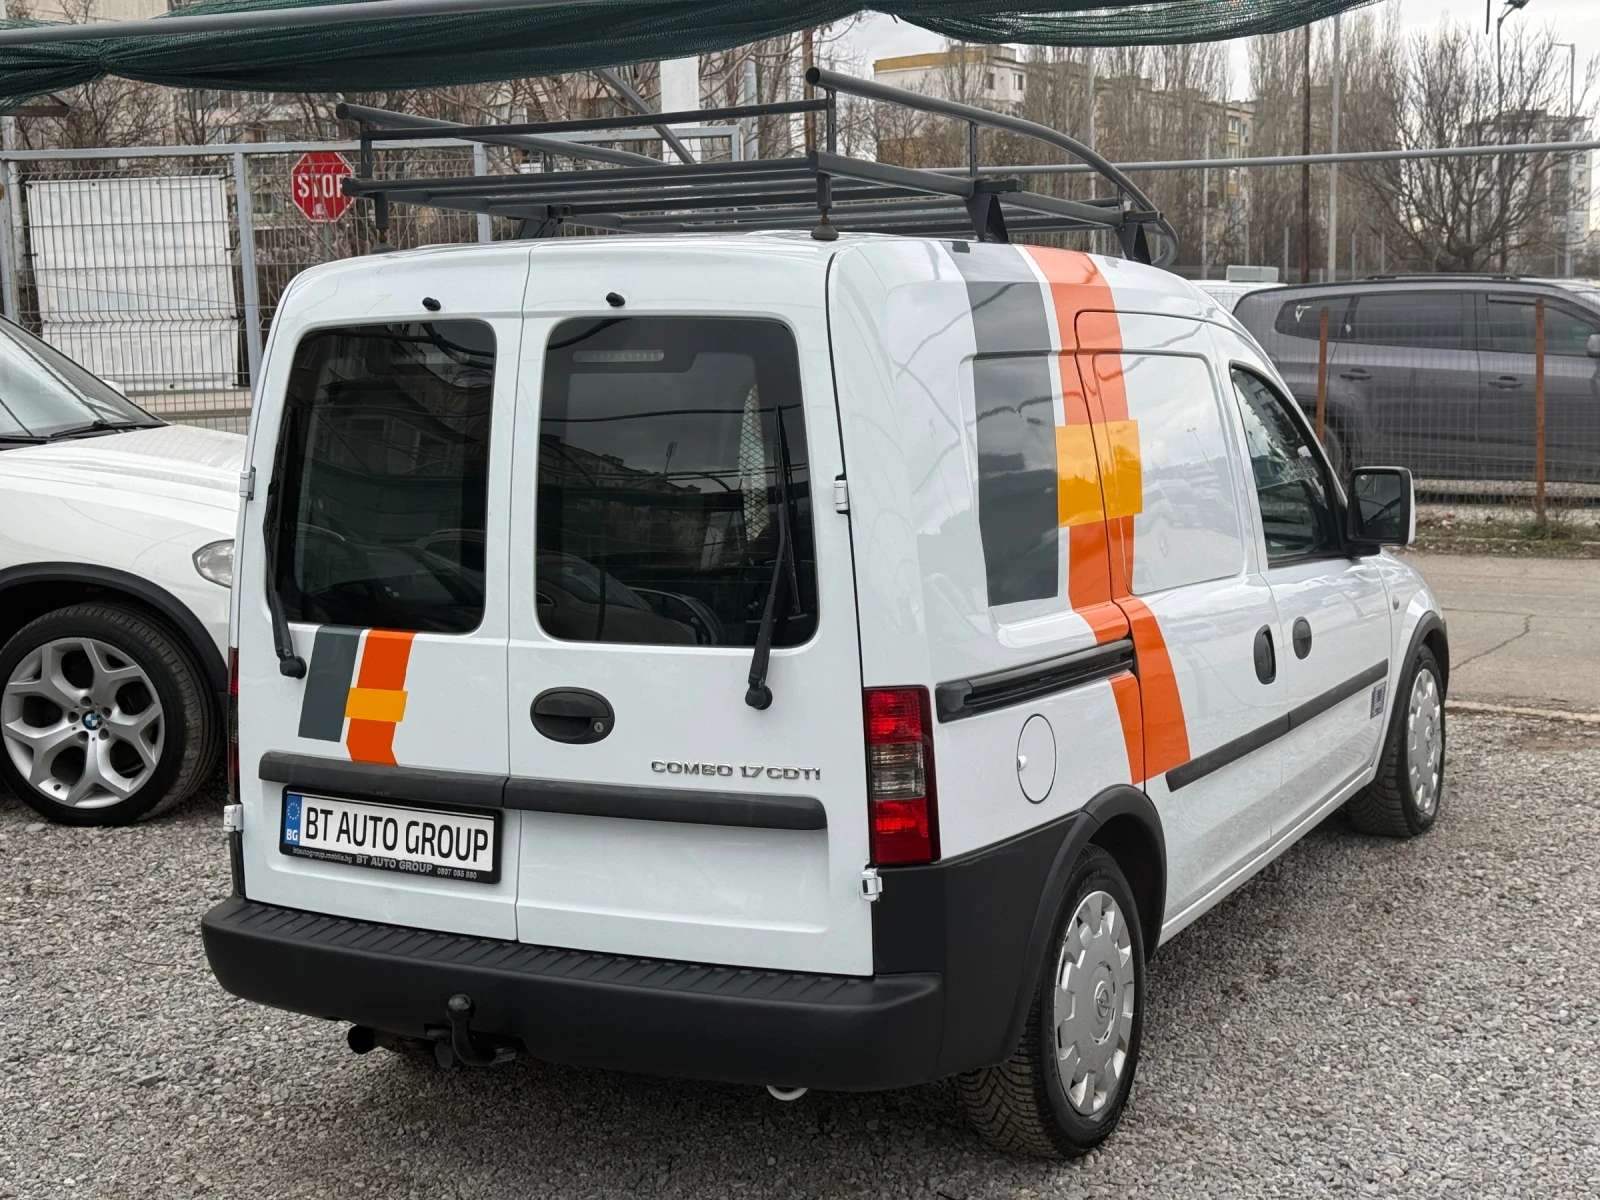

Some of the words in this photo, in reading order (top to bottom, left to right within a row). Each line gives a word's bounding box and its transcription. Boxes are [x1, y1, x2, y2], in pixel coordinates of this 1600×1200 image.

[651, 760, 734, 777] COMBO
[286, 829, 299, 842] BG
[305, 806, 334, 842] BT
[335, 811, 398, 851] AUTO
[405, 820, 489, 863] GROUP
[356, 854, 369, 865] BT
[370, 856, 397, 869] AUTO
[398, 860, 433, 873] GROUP
